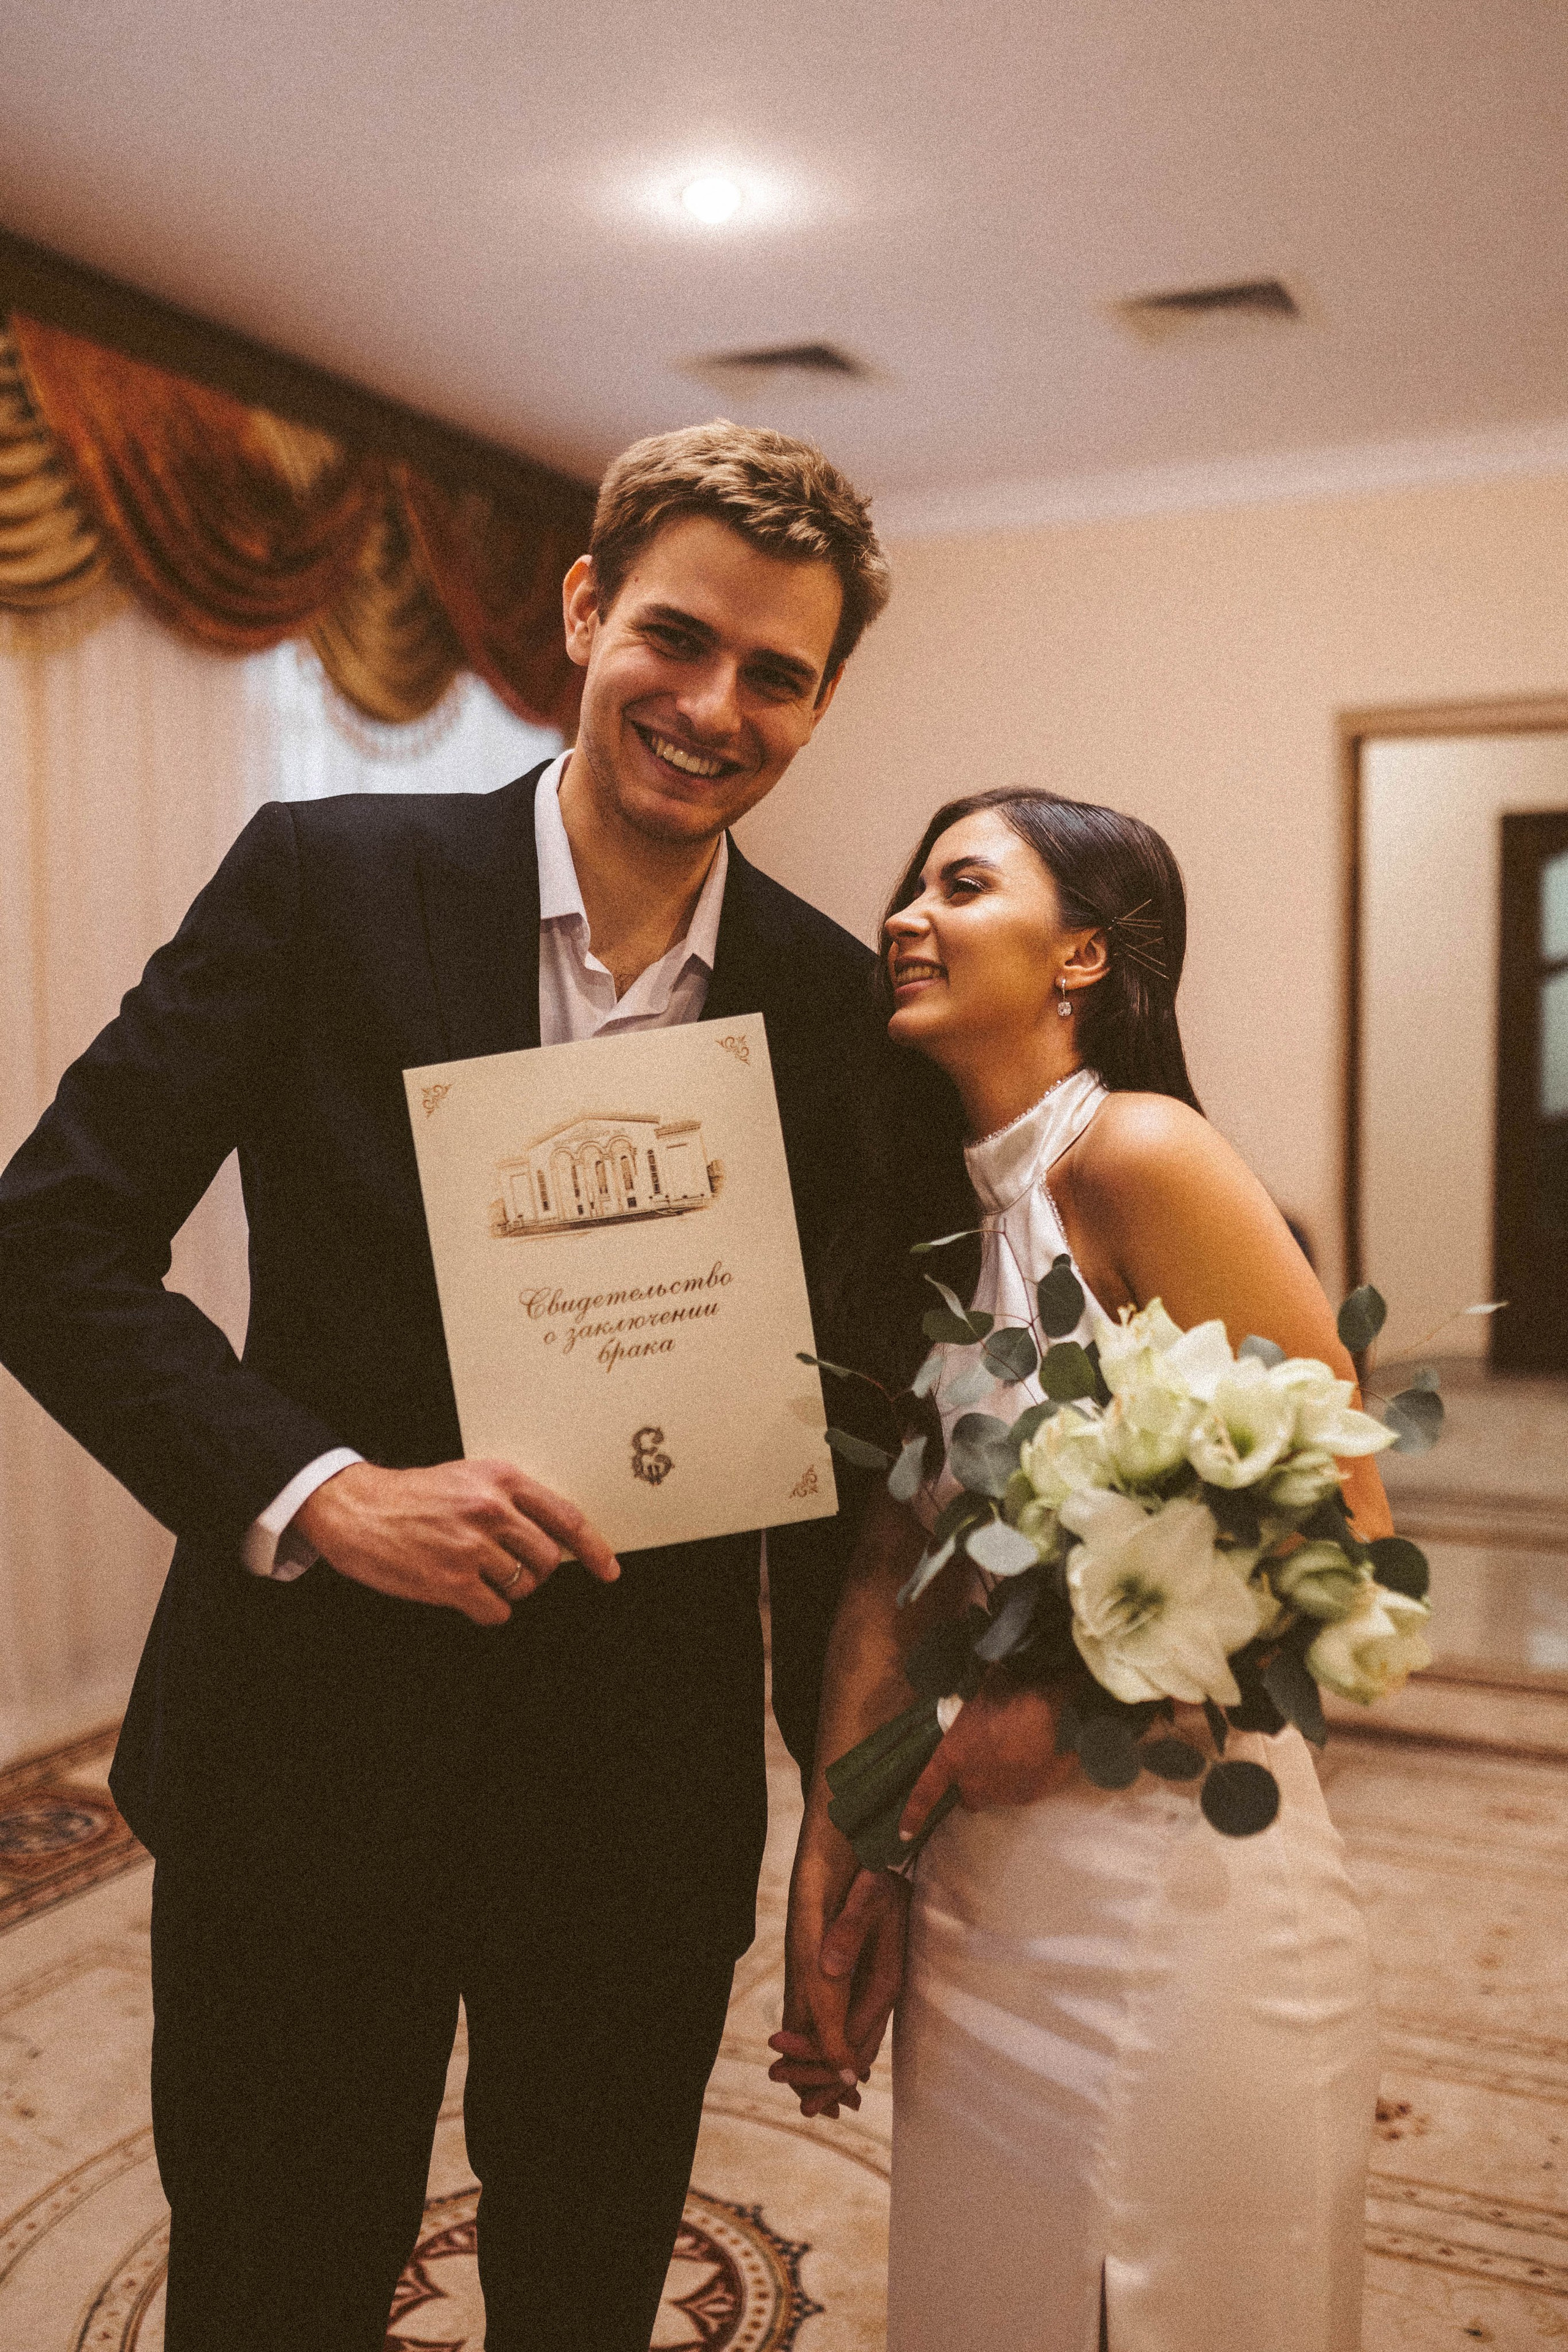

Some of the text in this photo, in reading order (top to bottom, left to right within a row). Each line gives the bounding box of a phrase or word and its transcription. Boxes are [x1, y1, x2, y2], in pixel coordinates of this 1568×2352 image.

[518, 1261, 733, 1324] Свидетельство
[543, 1302, 720, 1354] о заключении
[597, 1336, 675, 1374] брака
